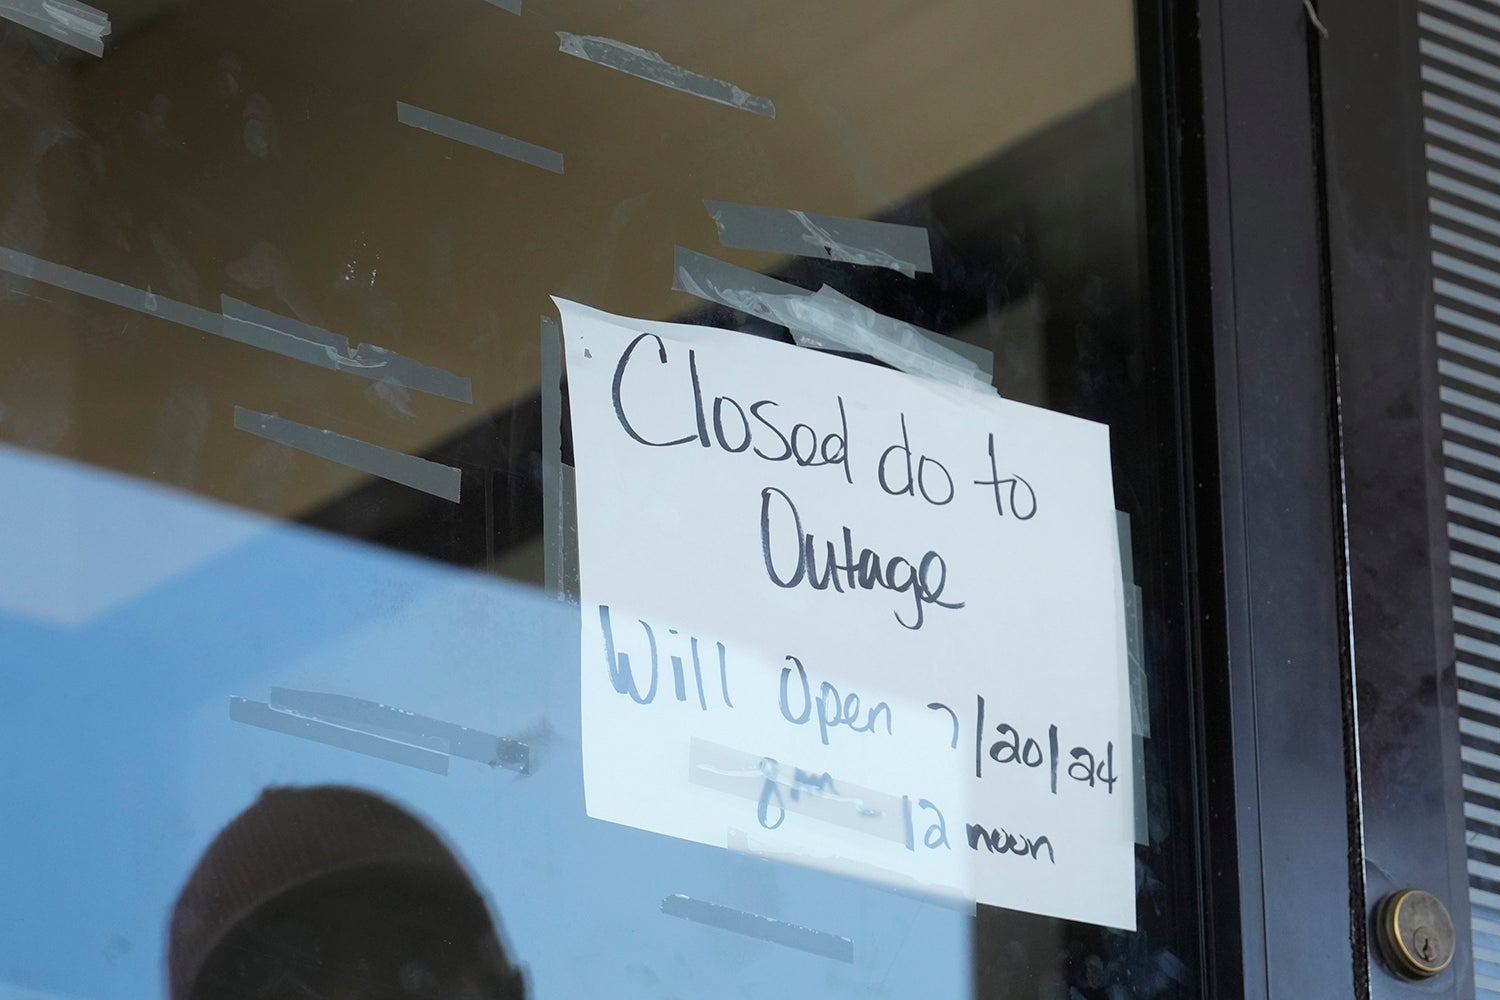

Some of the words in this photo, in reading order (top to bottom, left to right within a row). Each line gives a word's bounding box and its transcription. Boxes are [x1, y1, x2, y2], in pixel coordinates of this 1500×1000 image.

[611, 332, 853, 484] Closed
[878, 412, 956, 506] do
[974, 433, 1038, 521] to
[760, 487, 967, 630] Outage
[599, 604, 734, 711] Will
[900, 795, 952, 852] 12
[966, 823, 1055, 865] noon
